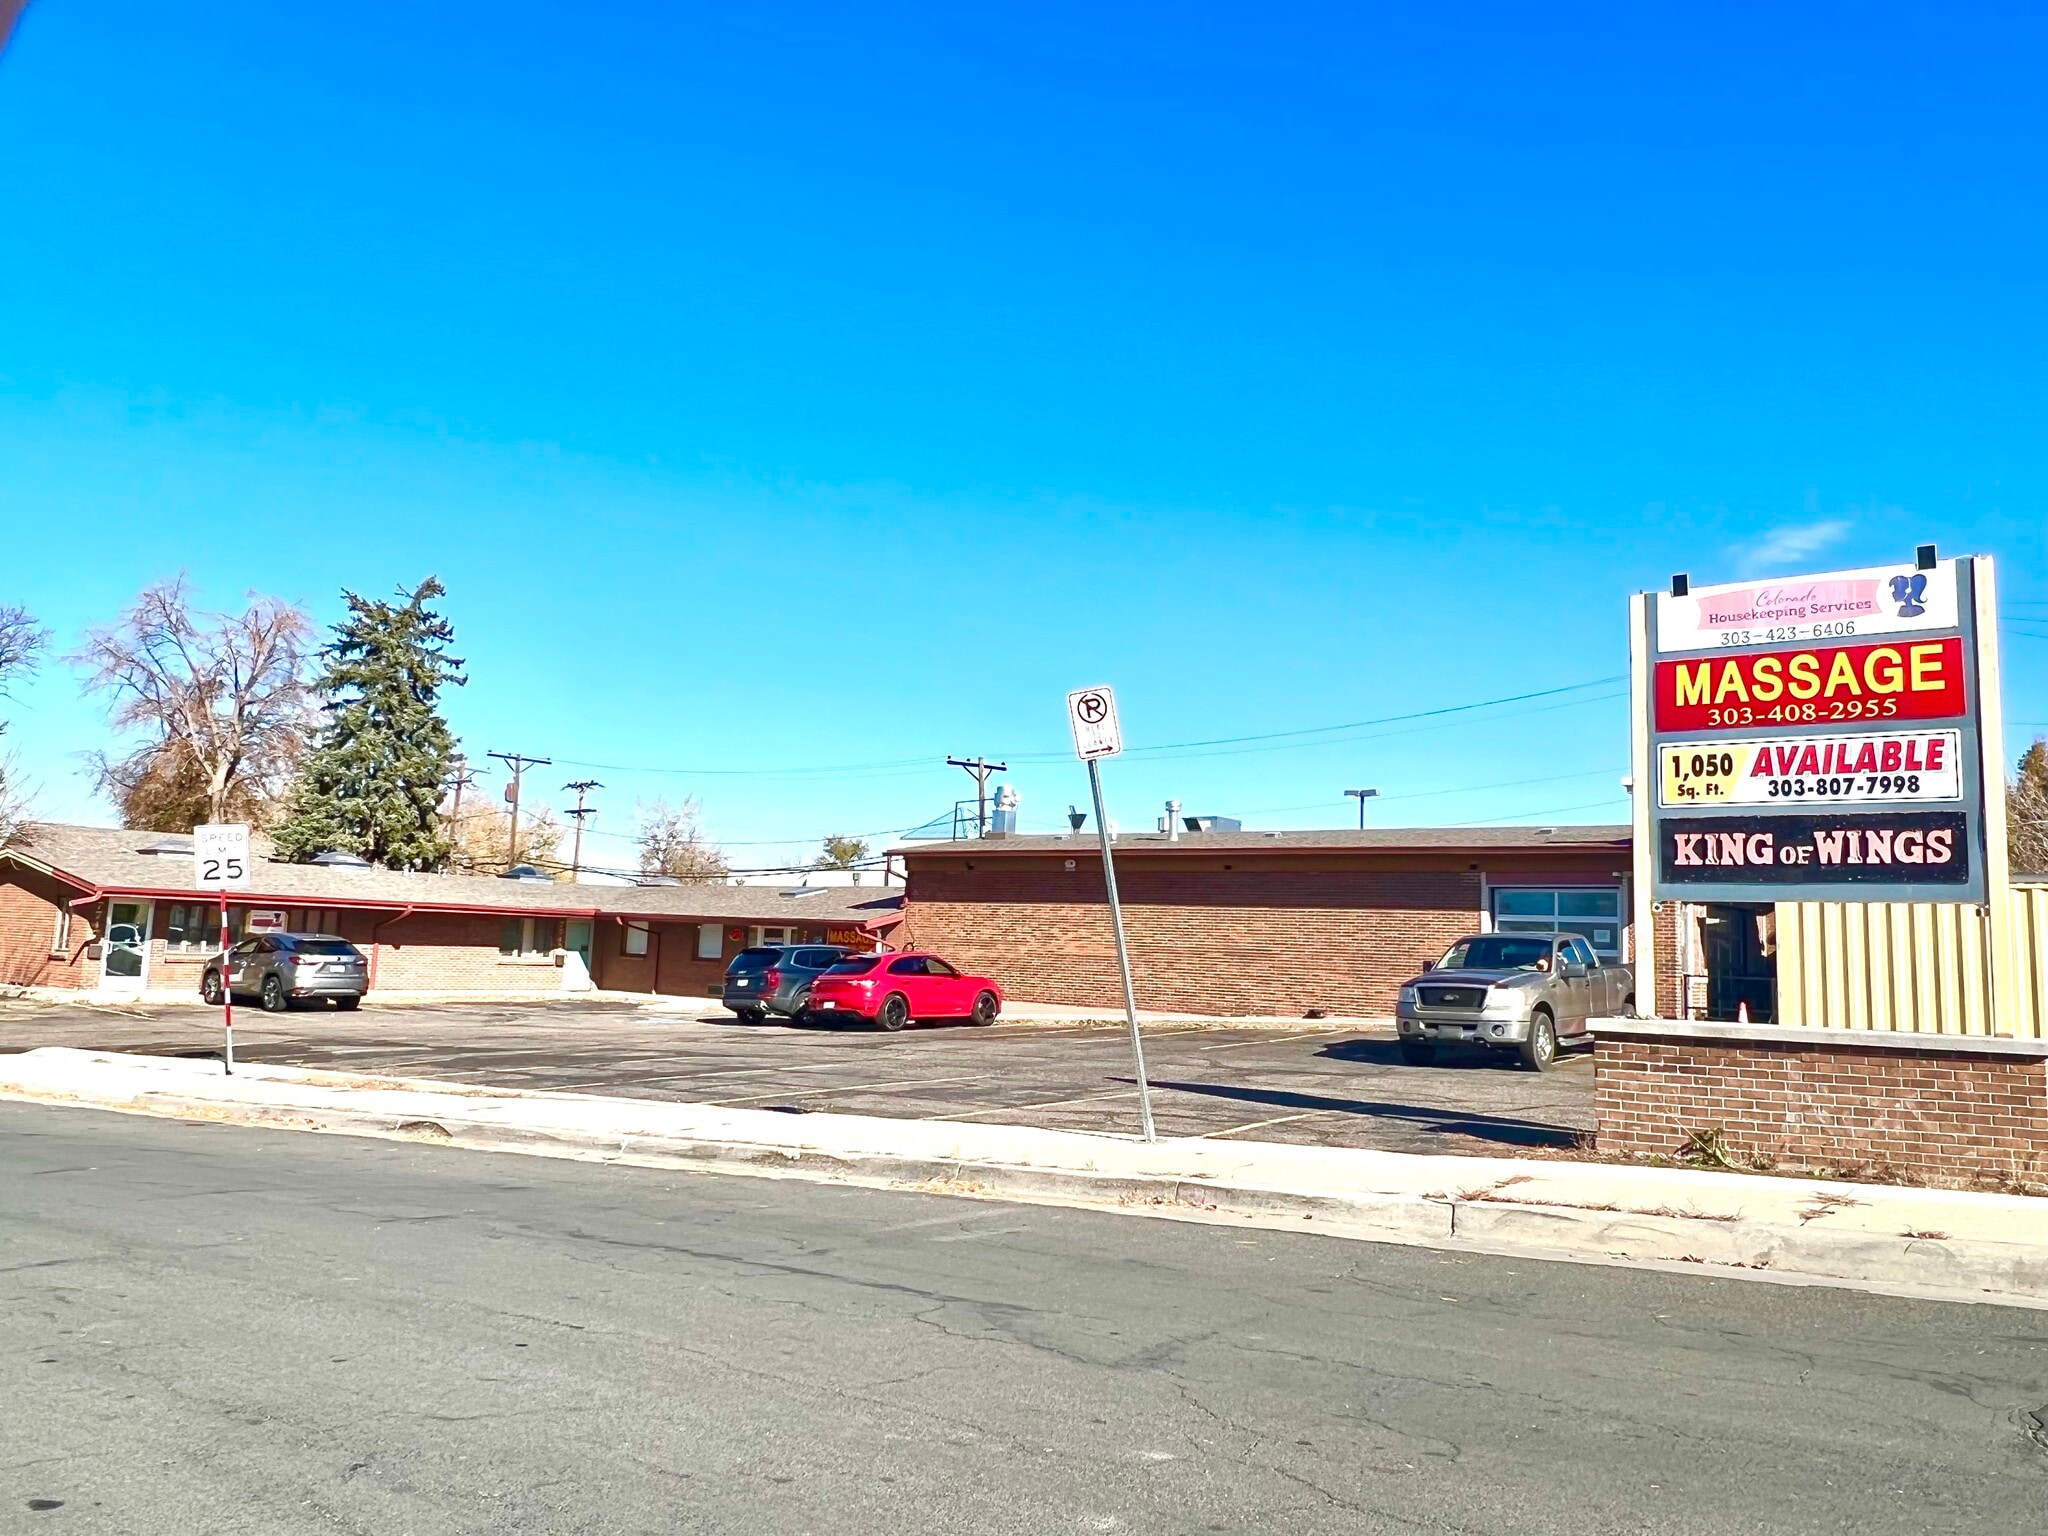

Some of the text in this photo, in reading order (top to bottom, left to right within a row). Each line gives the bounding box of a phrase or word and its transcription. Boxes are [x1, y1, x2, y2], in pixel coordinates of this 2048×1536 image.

[1756, 585, 1817, 607] Colorado
[1708, 600, 1873, 624] Housekeeping Services
[1720, 621, 1856, 646] 303-423-6406
[1675, 644, 1946, 707] MASSAGE
[1707, 698, 1898, 726] 303-408-2955
[1671, 753, 1734, 781] 1,050
[1750, 738, 1946, 778] AVAILABLE
[1677, 783, 1725, 800] Sq. Ft.
[1768, 775, 1921, 797] 303-807-7998
[201, 832, 243, 843] SPEED
[1674, 829, 1953, 866] KING OF WINGS
[203, 858, 243, 880] 25
